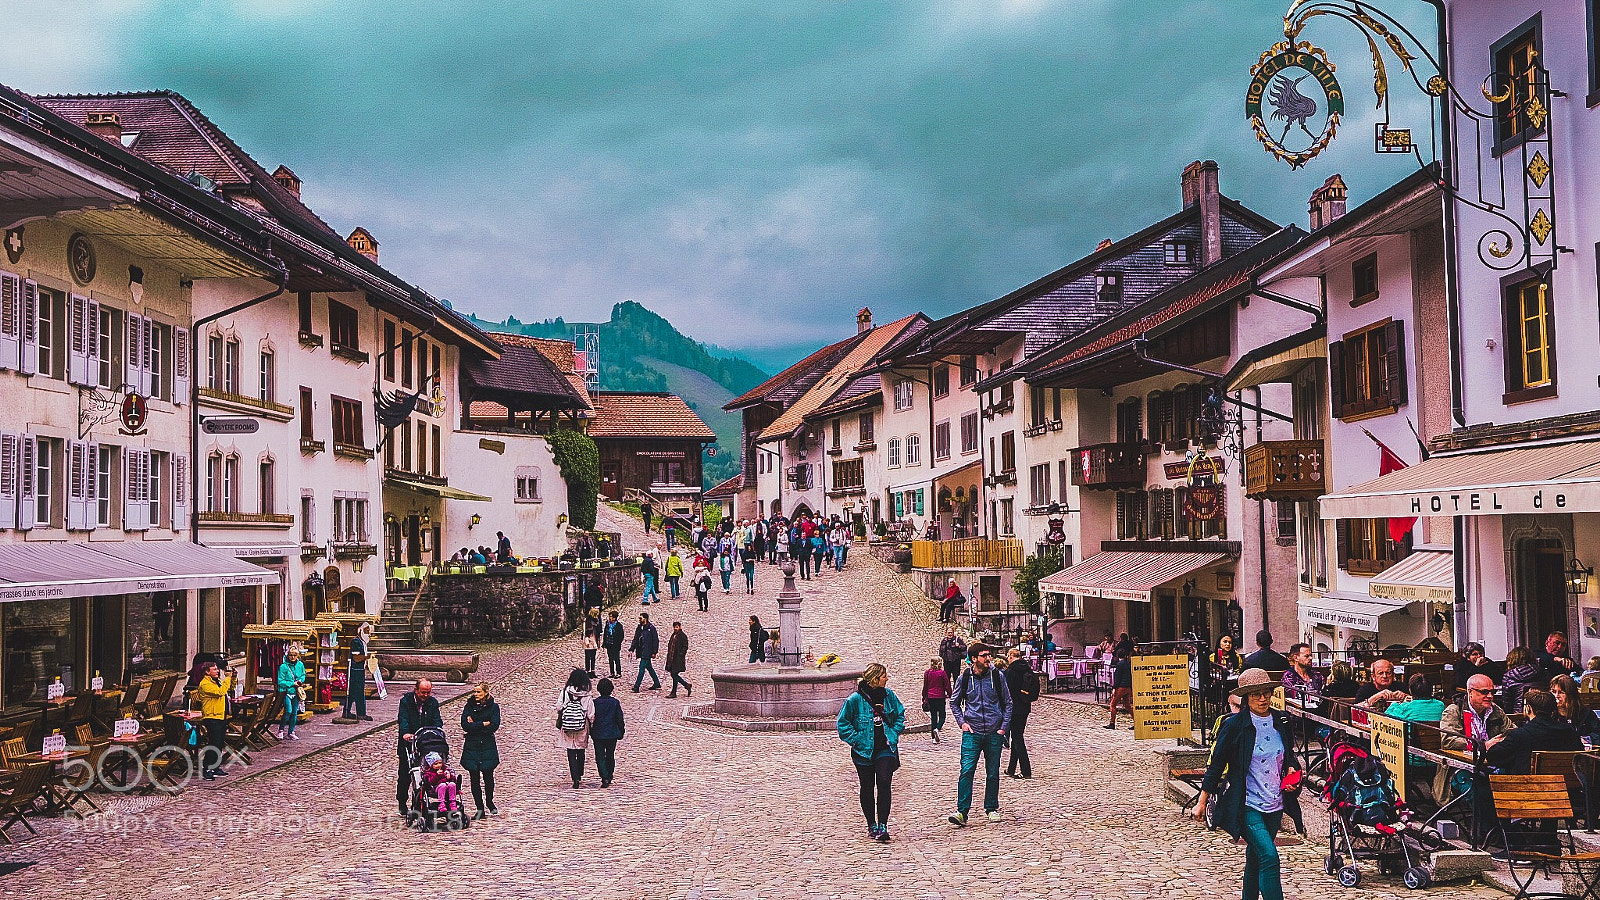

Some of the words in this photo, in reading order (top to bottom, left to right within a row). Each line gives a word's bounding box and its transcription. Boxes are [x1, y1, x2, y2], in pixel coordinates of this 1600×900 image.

[1248, 59, 1282, 104] HOTEL
[1284, 54, 1308, 67] DE
[1312, 60, 1341, 100] VILLE
[1411, 492, 1503, 514] HOTEL
[1533, 490, 1566, 509] de
[23, 588, 36, 597] dans
[1307, 609, 1325, 620] Artisanat
[1337, 614, 1357, 625] populaire
[1357, 617, 1371, 627] suisse
[1372, 720, 1379, 730] Le
[1381, 752, 1396, 765] ONDUE
